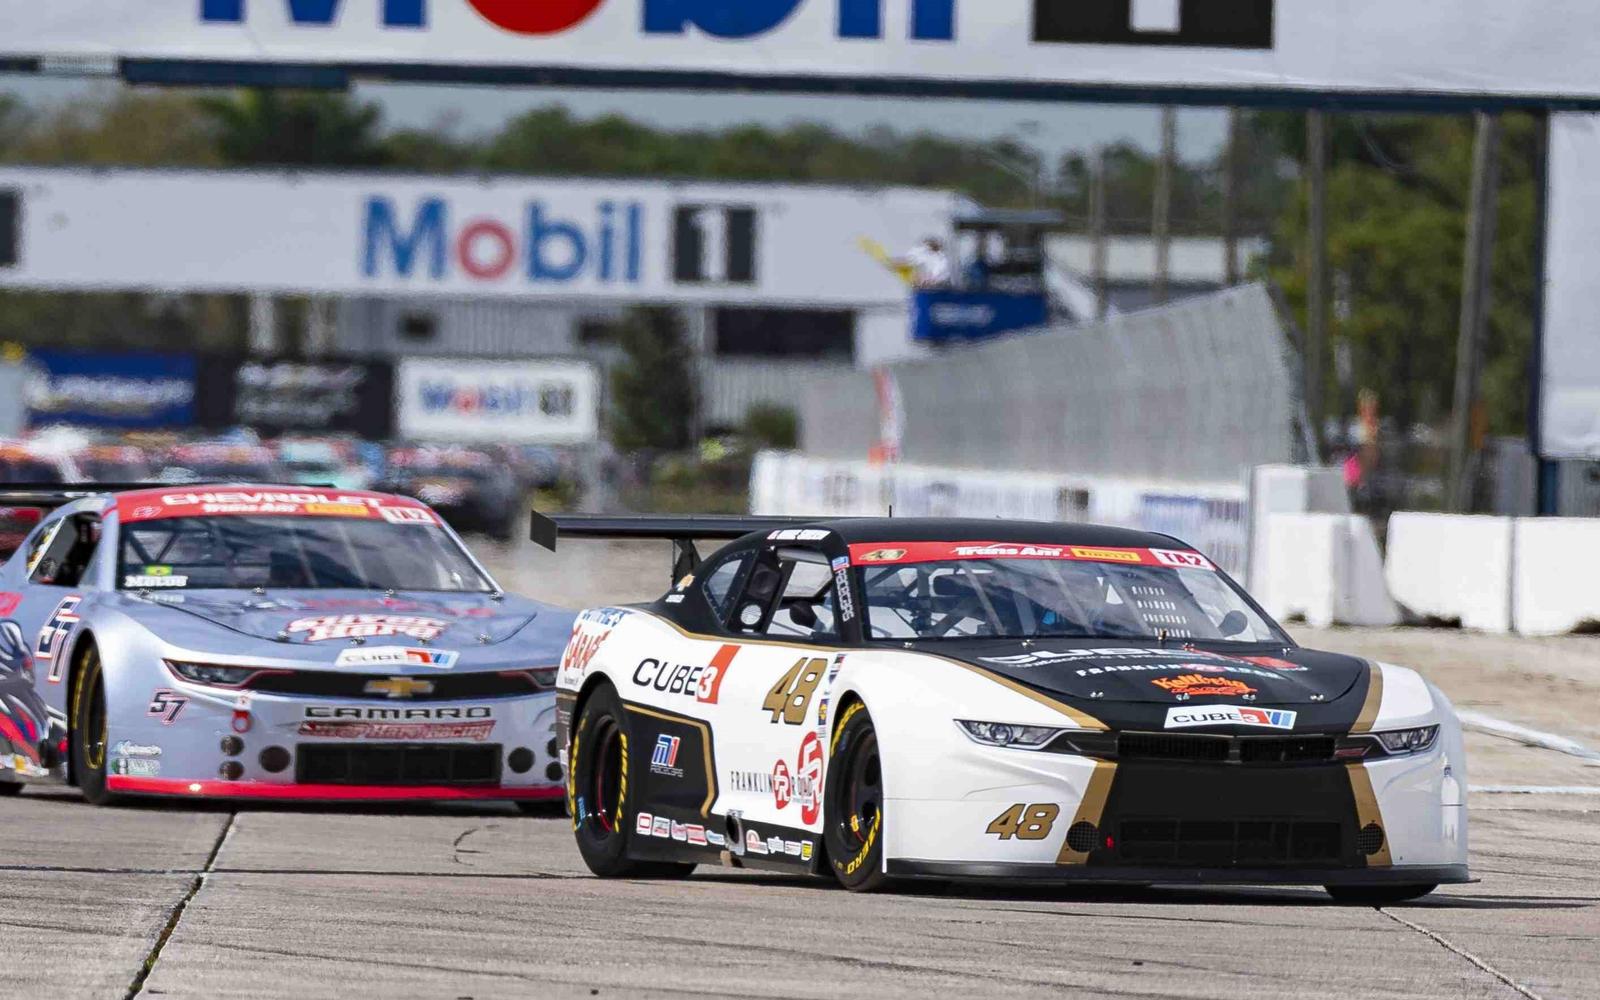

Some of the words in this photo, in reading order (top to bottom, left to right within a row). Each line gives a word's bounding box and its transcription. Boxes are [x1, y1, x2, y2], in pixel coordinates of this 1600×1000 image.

[362, 195, 642, 282] Mobil
[162, 493, 386, 509] CHEVROLET
[954, 546, 1018, 557] Trans
[1020, 546, 1063, 557] Am
[1162, 551, 1203, 567] TA2
[762, 656, 828, 725] 48
[144, 687, 192, 727] 57
[304, 706, 493, 719] CAMARO
[730, 769, 775, 794] FRANKLIN
[985, 803, 1061, 840] 48
